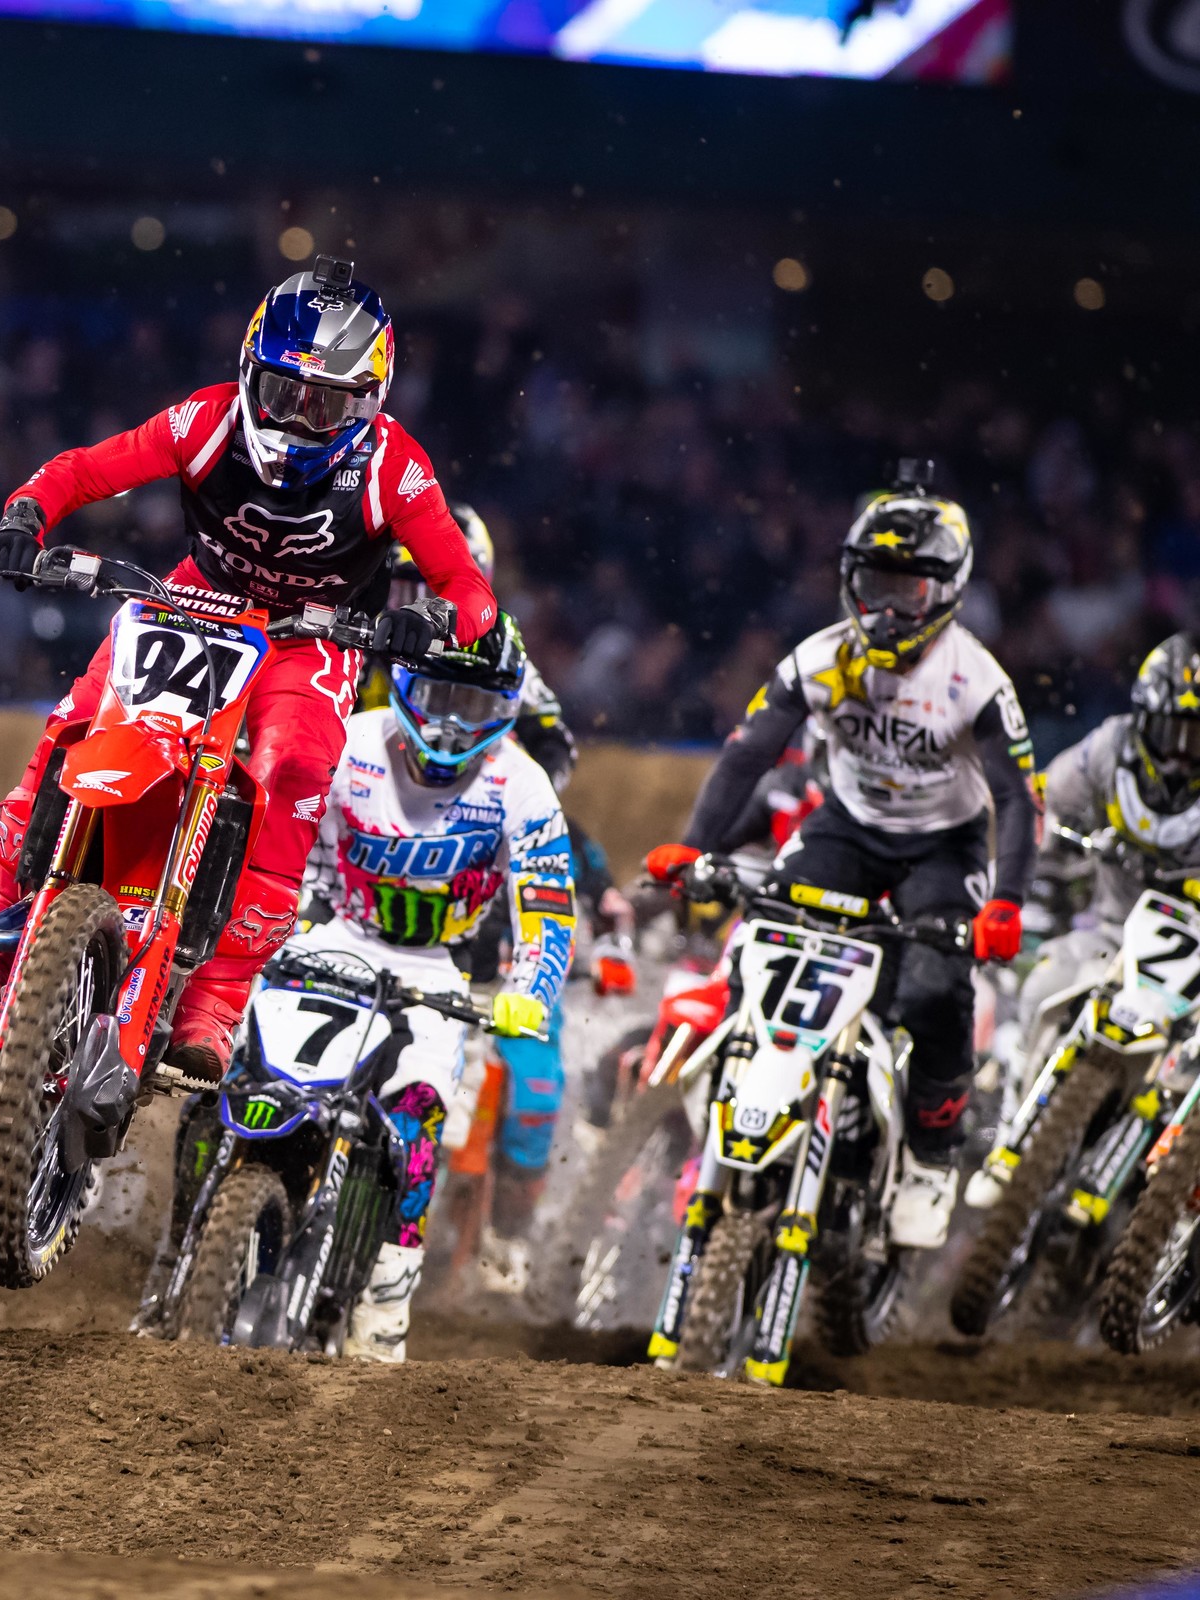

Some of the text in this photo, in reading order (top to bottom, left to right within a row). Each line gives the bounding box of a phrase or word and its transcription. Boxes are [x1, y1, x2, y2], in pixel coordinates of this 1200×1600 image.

[332, 469, 361, 487] AOS
[405, 477, 440, 503] HOND
[198, 531, 349, 589] HONDA
[172, 595, 241, 618] ENTHAL
[131, 630, 244, 720] 94
[140, 714, 178, 728] HONDA
[71, 782, 124, 798] HONDA
[122, 967, 143, 1013] YUTAKA
[759, 953, 855, 1032] 15
[294, 996, 360, 1068] 7
